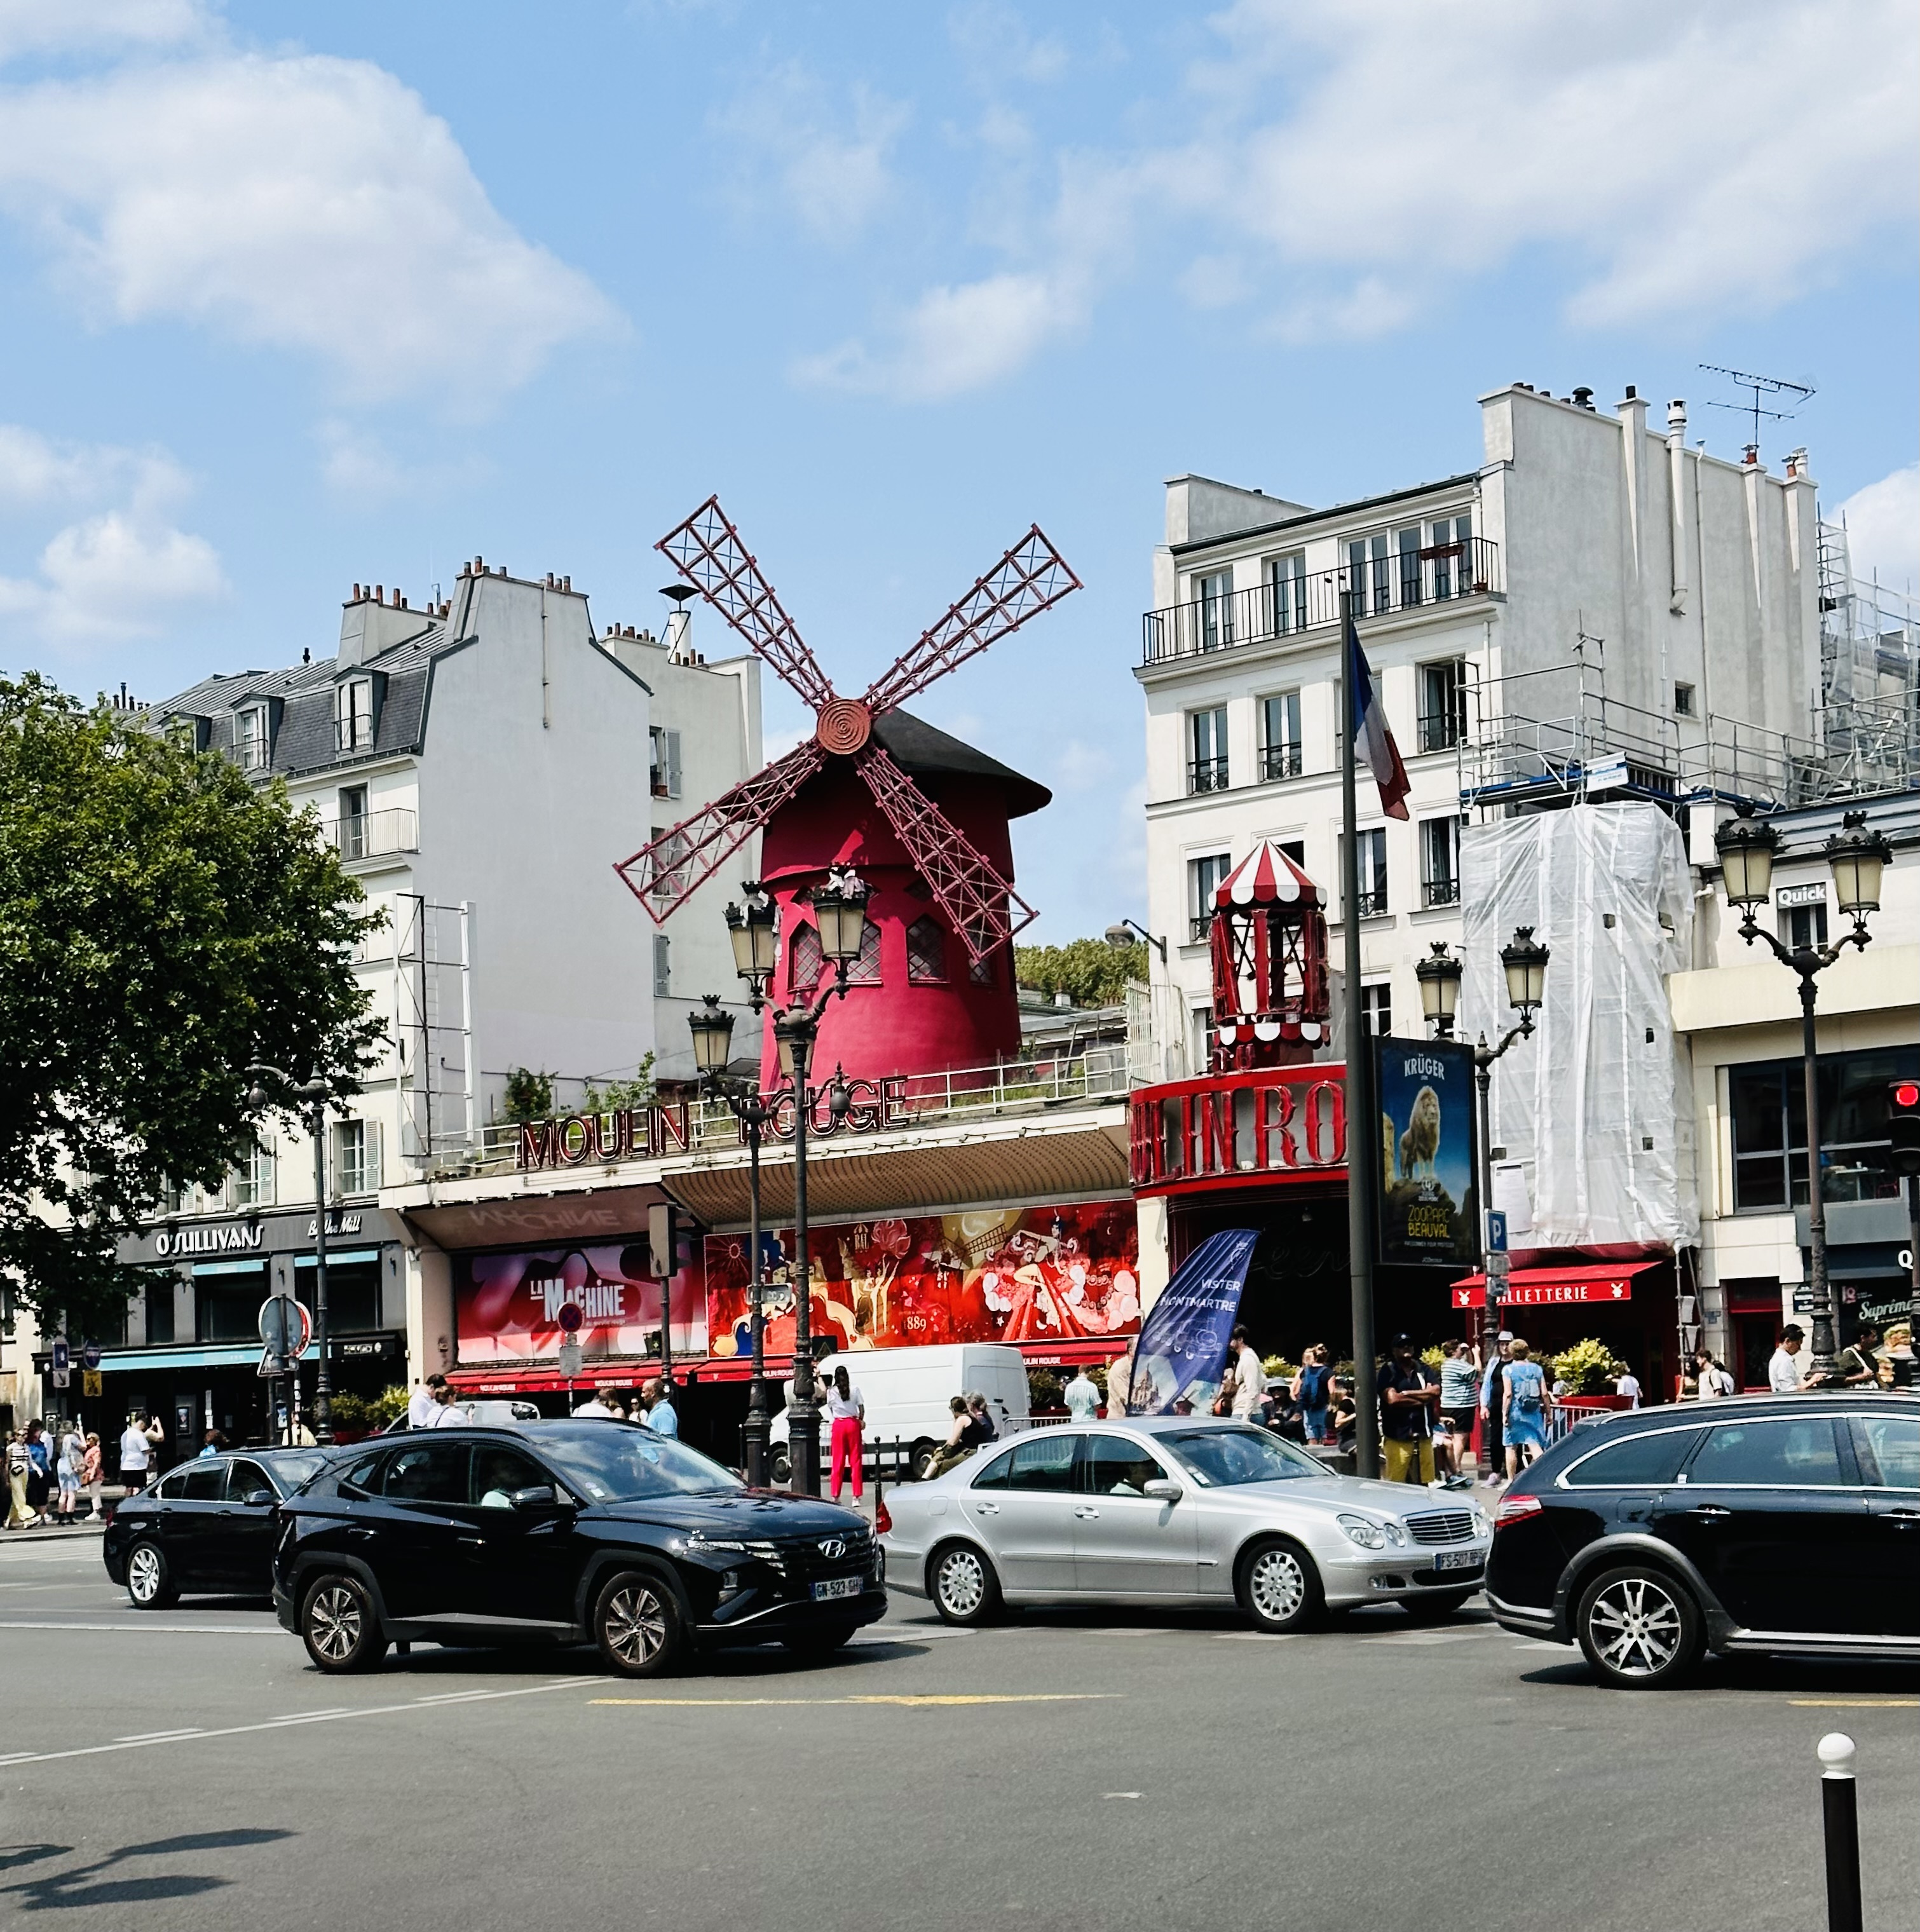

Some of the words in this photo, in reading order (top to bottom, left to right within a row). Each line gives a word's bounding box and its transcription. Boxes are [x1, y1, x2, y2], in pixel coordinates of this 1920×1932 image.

[1778, 885, 1825, 907] Quick
[1405, 1053, 1445, 1080] KRÜGER
[520, 1103, 690, 1169] MOULIN
[339, 1215, 361, 1234] Mill
[1408, 1222, 1450, 1239] BEAUVAL
[1494, 1220, 1502, 1244] P
[156, 1225, 264, 1255] O'SULLIVANS
[530, 1280, 543, 1295] LA
